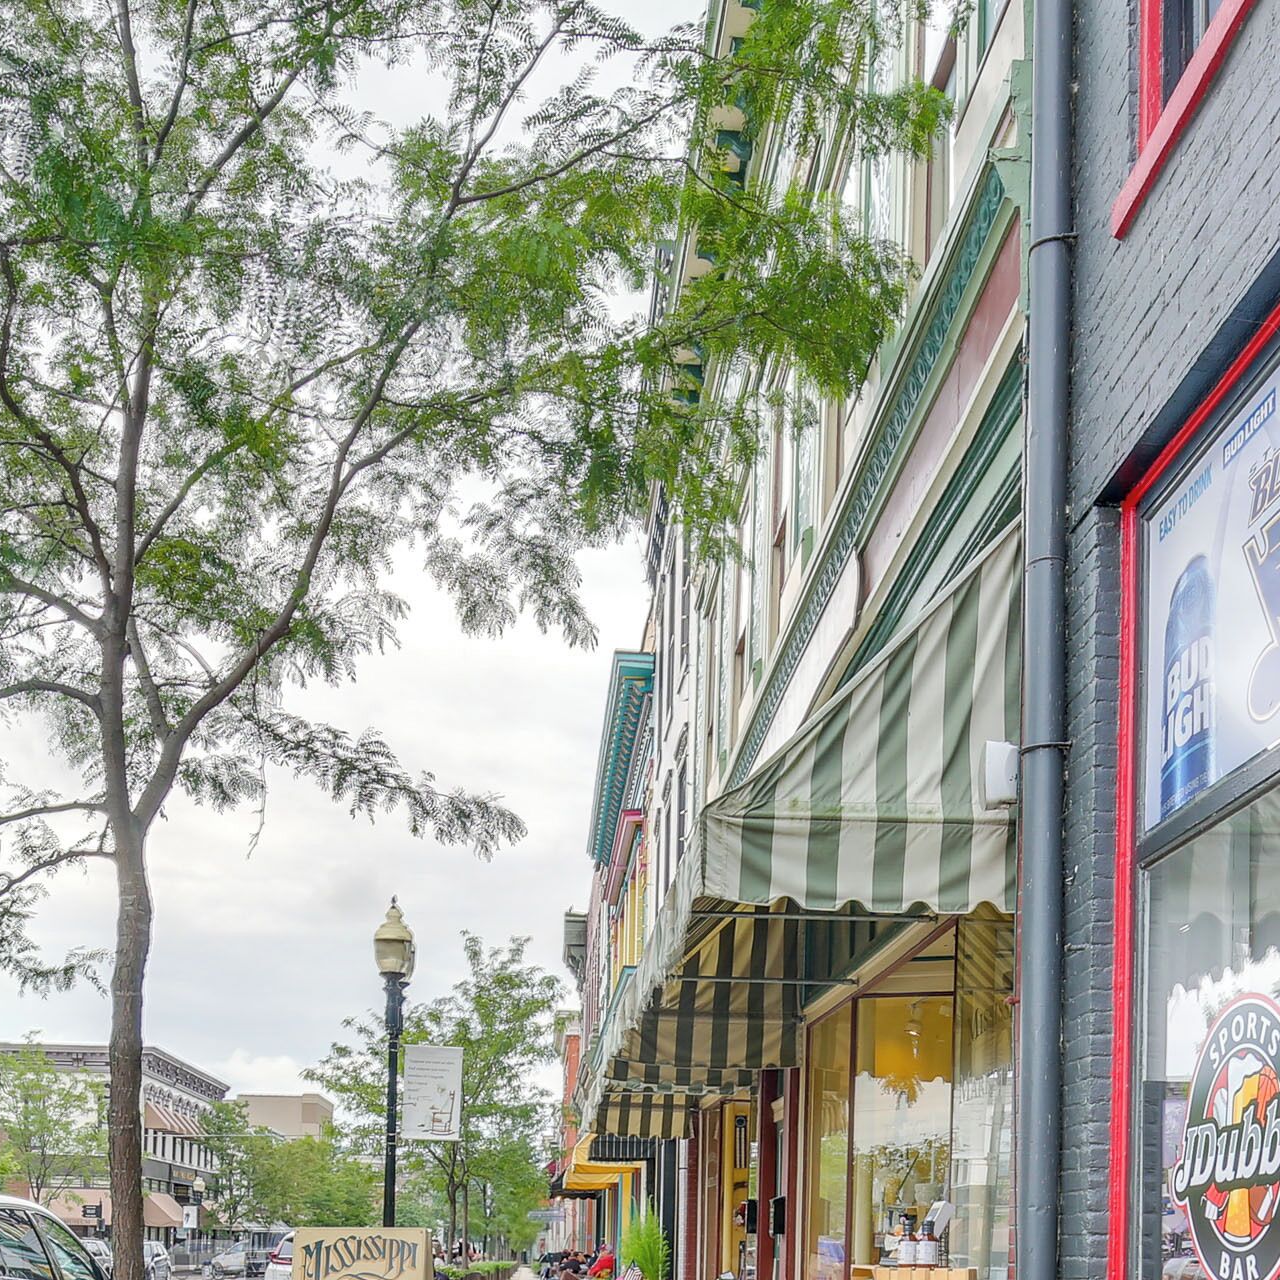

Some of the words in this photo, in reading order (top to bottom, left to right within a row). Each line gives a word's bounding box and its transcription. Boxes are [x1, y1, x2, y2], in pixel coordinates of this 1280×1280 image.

[1224, 434, 1244, 464] BUD
[1244, 392, 1275, 441] LIGHT
[1159, 507, 1177, 543] EASY
[1178, 494, 1189, 521] TO
[1188, 464, 1213, 508] DRINK
[1167, 636, 1215, 715] BUD
[1209, 1012, 1280, 1069] SPORTS
